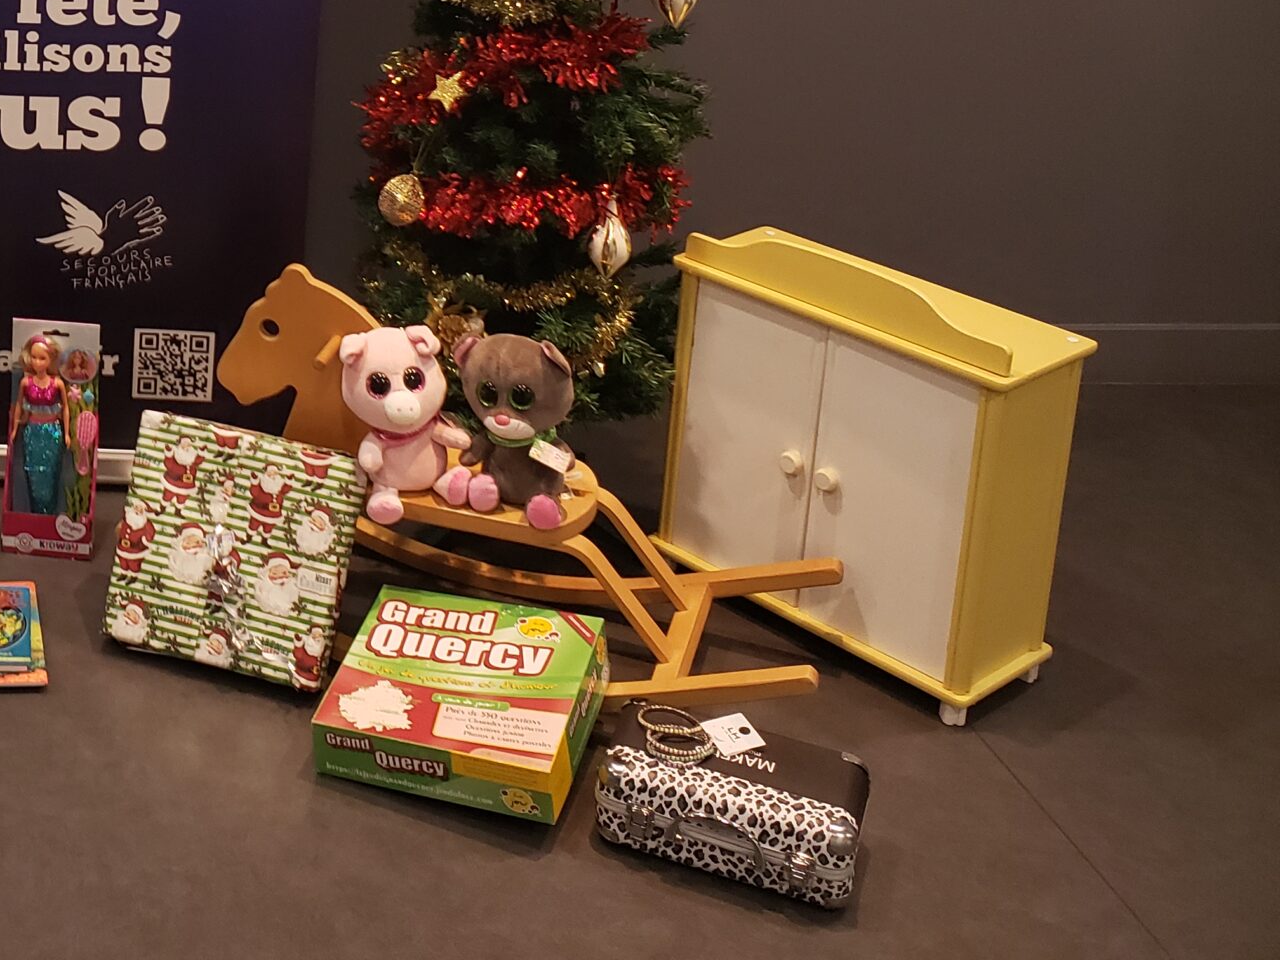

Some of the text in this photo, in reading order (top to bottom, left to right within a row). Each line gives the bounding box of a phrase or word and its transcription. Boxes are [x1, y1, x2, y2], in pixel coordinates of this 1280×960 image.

[60, 248, 151, 271] SECOURS
[87, 255, 173, 278] POPULAIRE
[71, 269, 151, 289] FRANÇAIS
[379, 599, 497, 636] Grand
[369, 623, 554, 676] Quercy
[326, 732, 370, 750] Grand
[375, 751, 445, 778] Quercy
